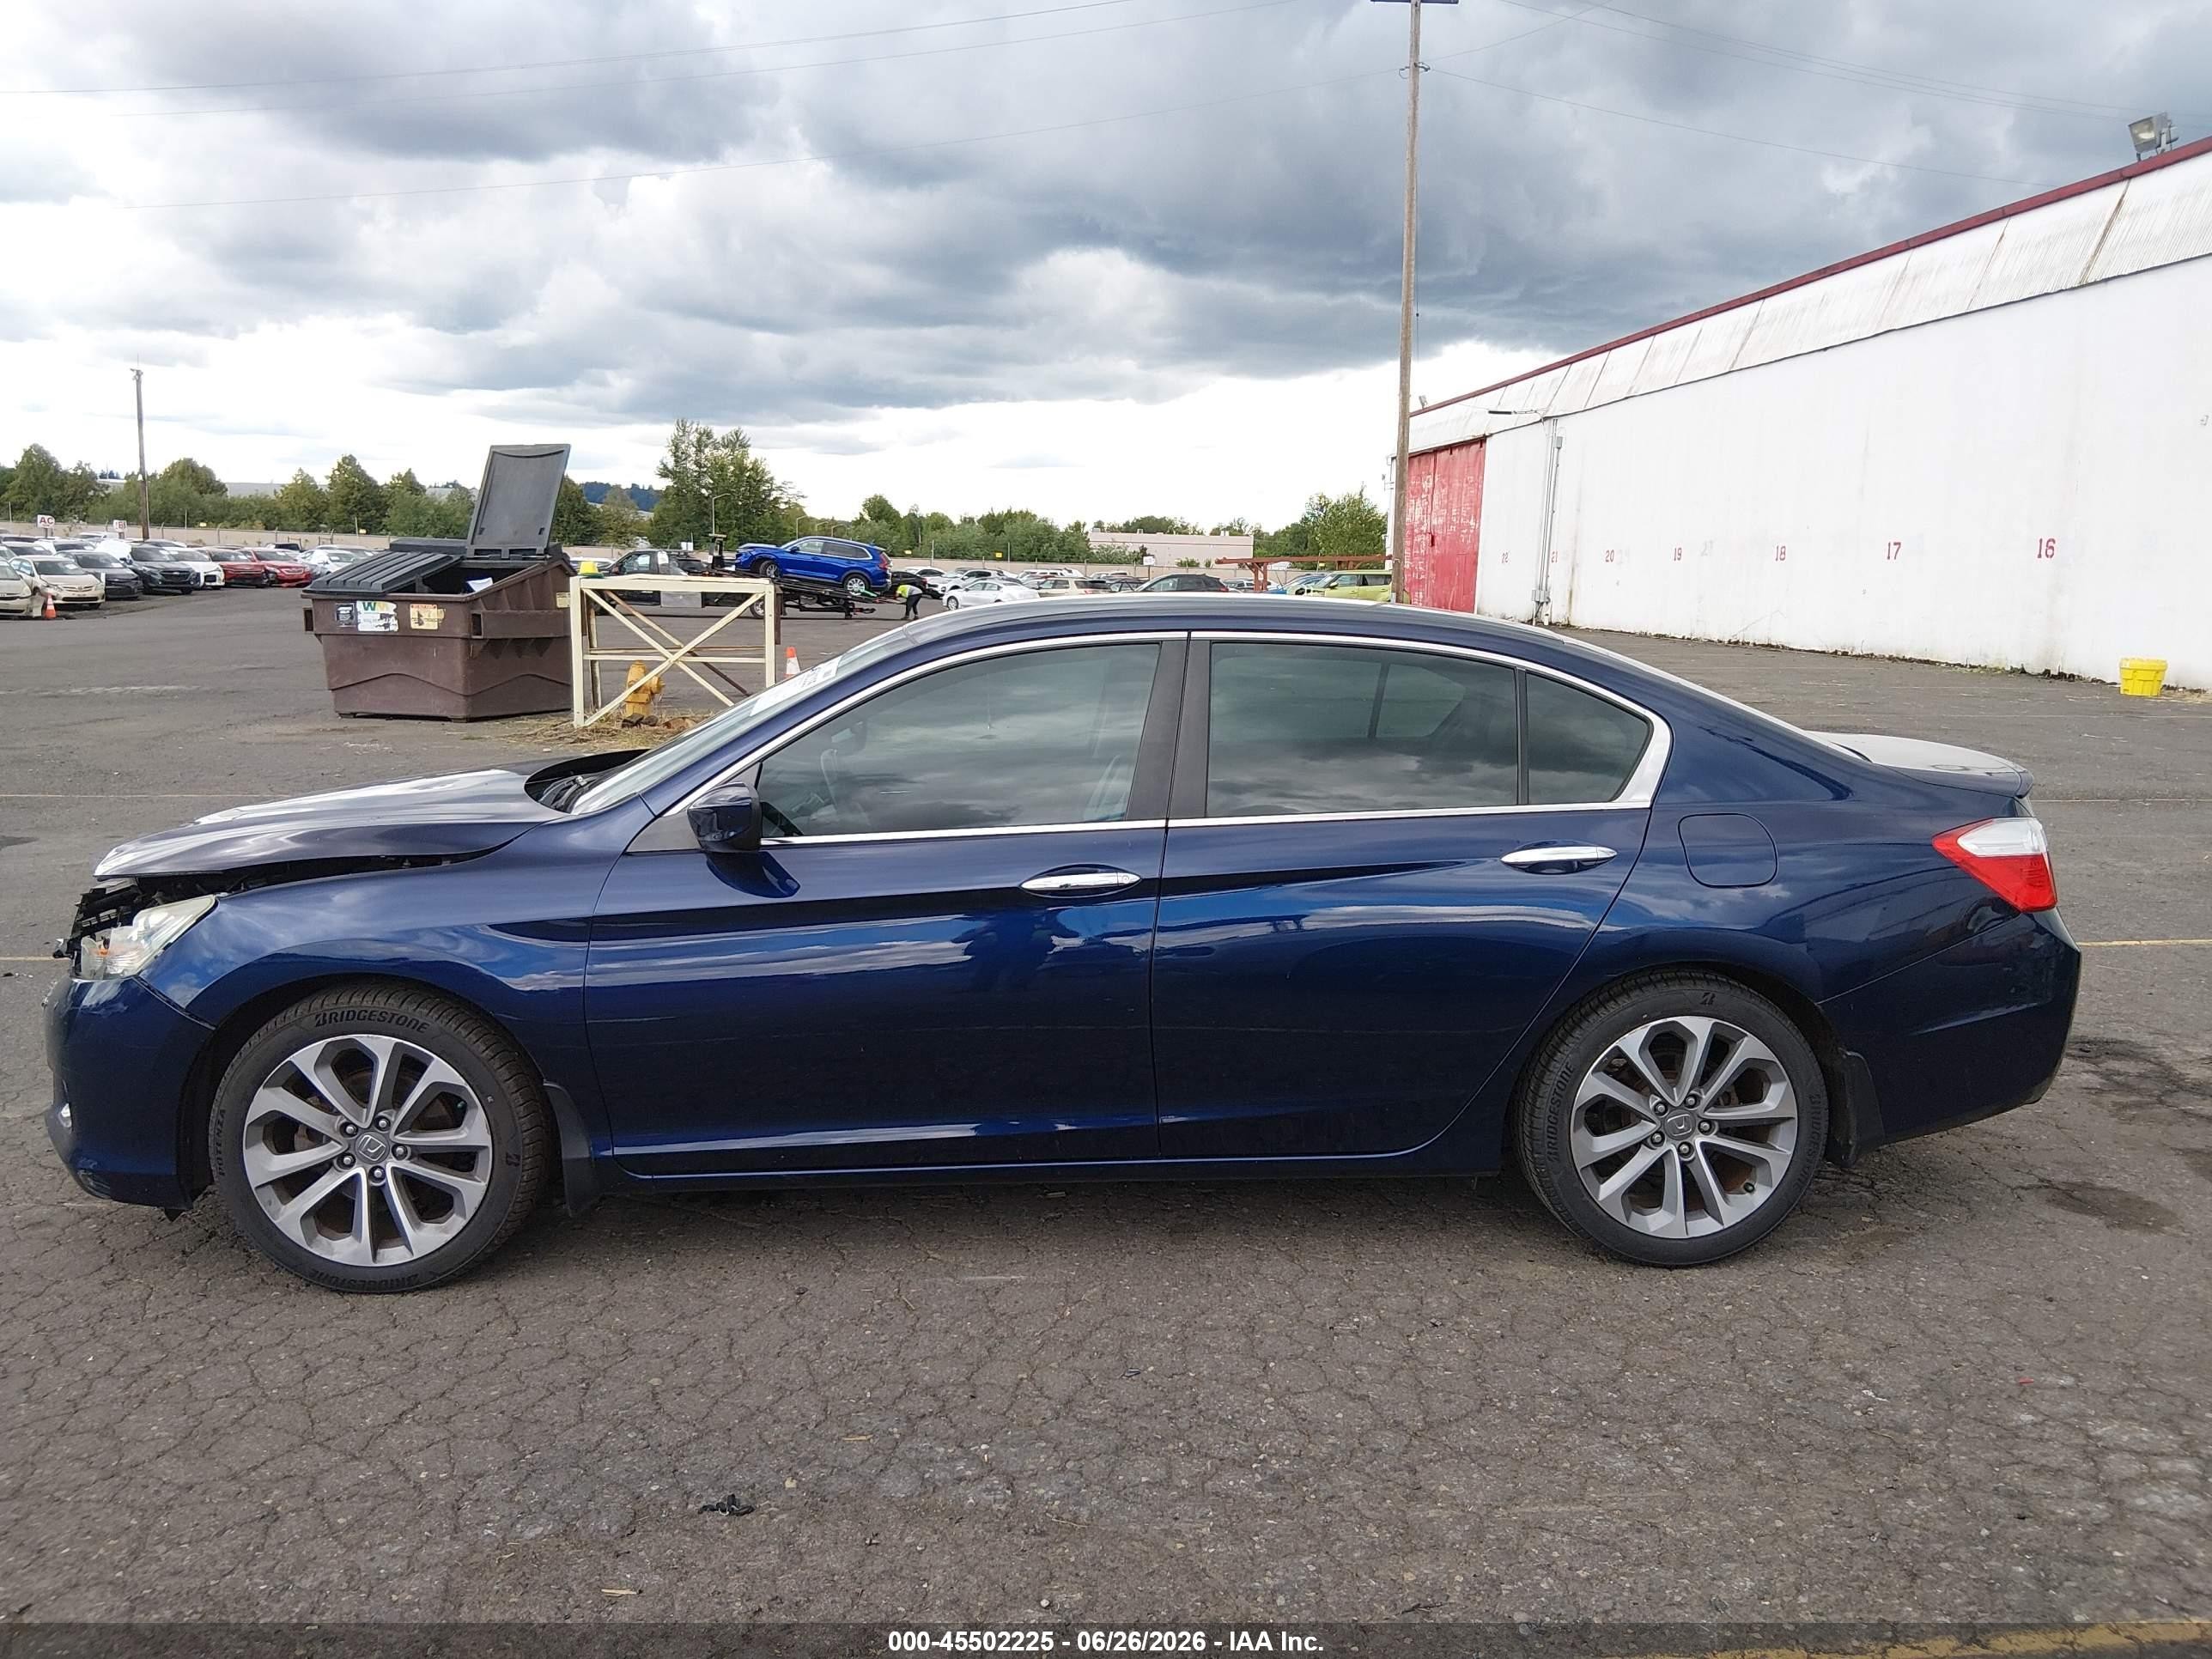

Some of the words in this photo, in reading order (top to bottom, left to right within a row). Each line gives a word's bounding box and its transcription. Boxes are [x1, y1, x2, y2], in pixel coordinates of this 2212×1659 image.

[1551, 550, 1559, 563] 21
[1605, 549, 1615, 563] 20
[1674, 547, 1683, 562] 19
[1775, 545, 1787, 562] 18
[1886, 541, 1902, 561] 17
[2037, 538, 2057, 559] 16
[314, 1009, 430, 1034] BRIDGESTONE
[1547, 1061, 1575, 1163] BRIDGESTONE
[216, 1109, 226, 1176] POTENZA
